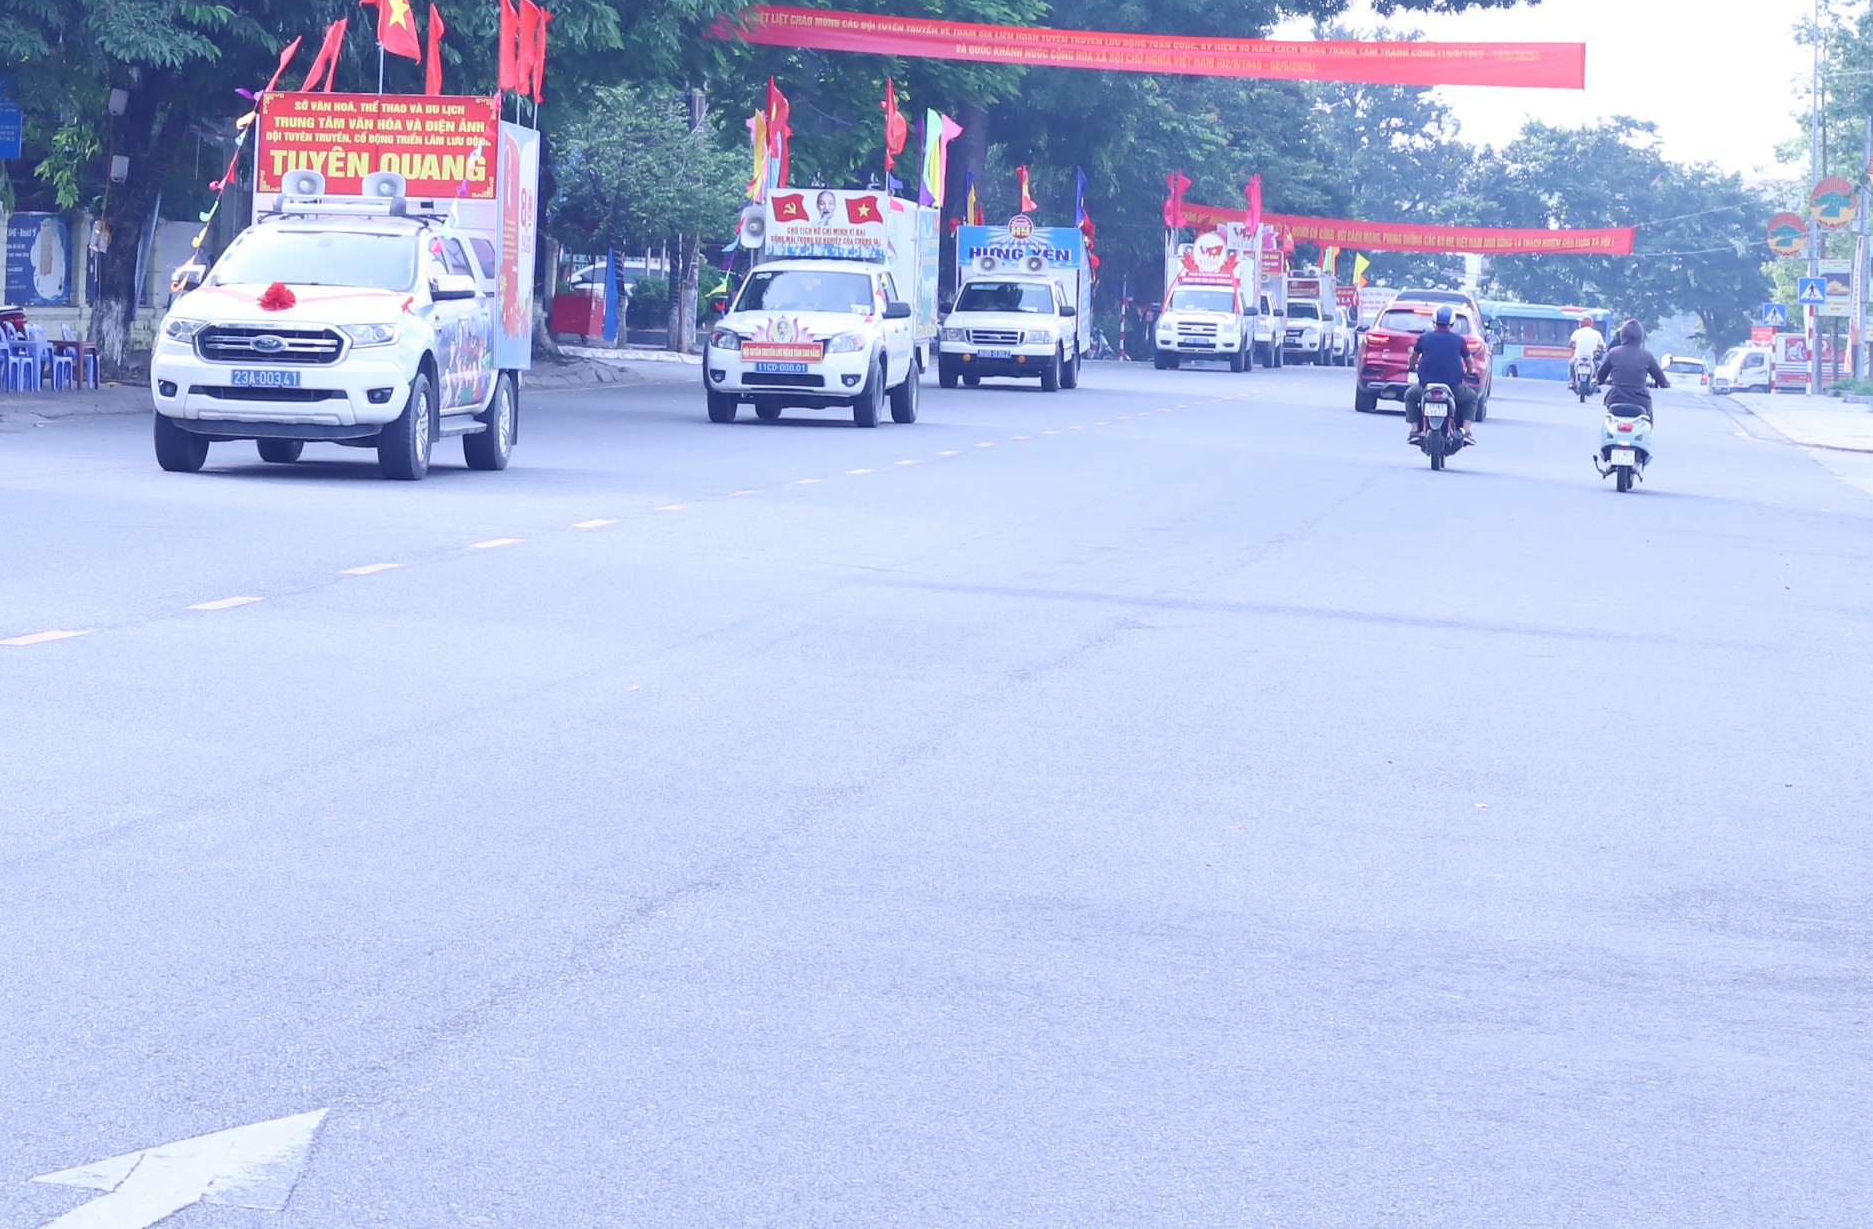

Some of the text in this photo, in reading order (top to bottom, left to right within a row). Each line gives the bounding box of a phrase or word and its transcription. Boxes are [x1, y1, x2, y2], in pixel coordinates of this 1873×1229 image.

[295, 99, 309, 111] SỞ
[311, 99, 331, 112] VĂN
[381, 103, 407, 114] THAO
[410, 101, 423, 114] VÀ
[426, 104, 439, 114] DU
[442, 105, 465, 116] LỊCH
[274, 116, 485, 135] TRUNG TÂM VĂN HÓA VÀ ĐIỆN ẢNH
[266, 130, 282, 143] ĐỘI
[284, 131, 313, 142] TUYÊN
[369, 133, 394, 146] ĐỘNG
[396, 132, 423, 145] TRIỂN
[425, 134, 444, 146] LÃM
[446, 135, 464, 146] LƯU
[269, 146, 487, 182] TUYÊN QUANG
[234, 370, 297, 386] 23A-003.41
